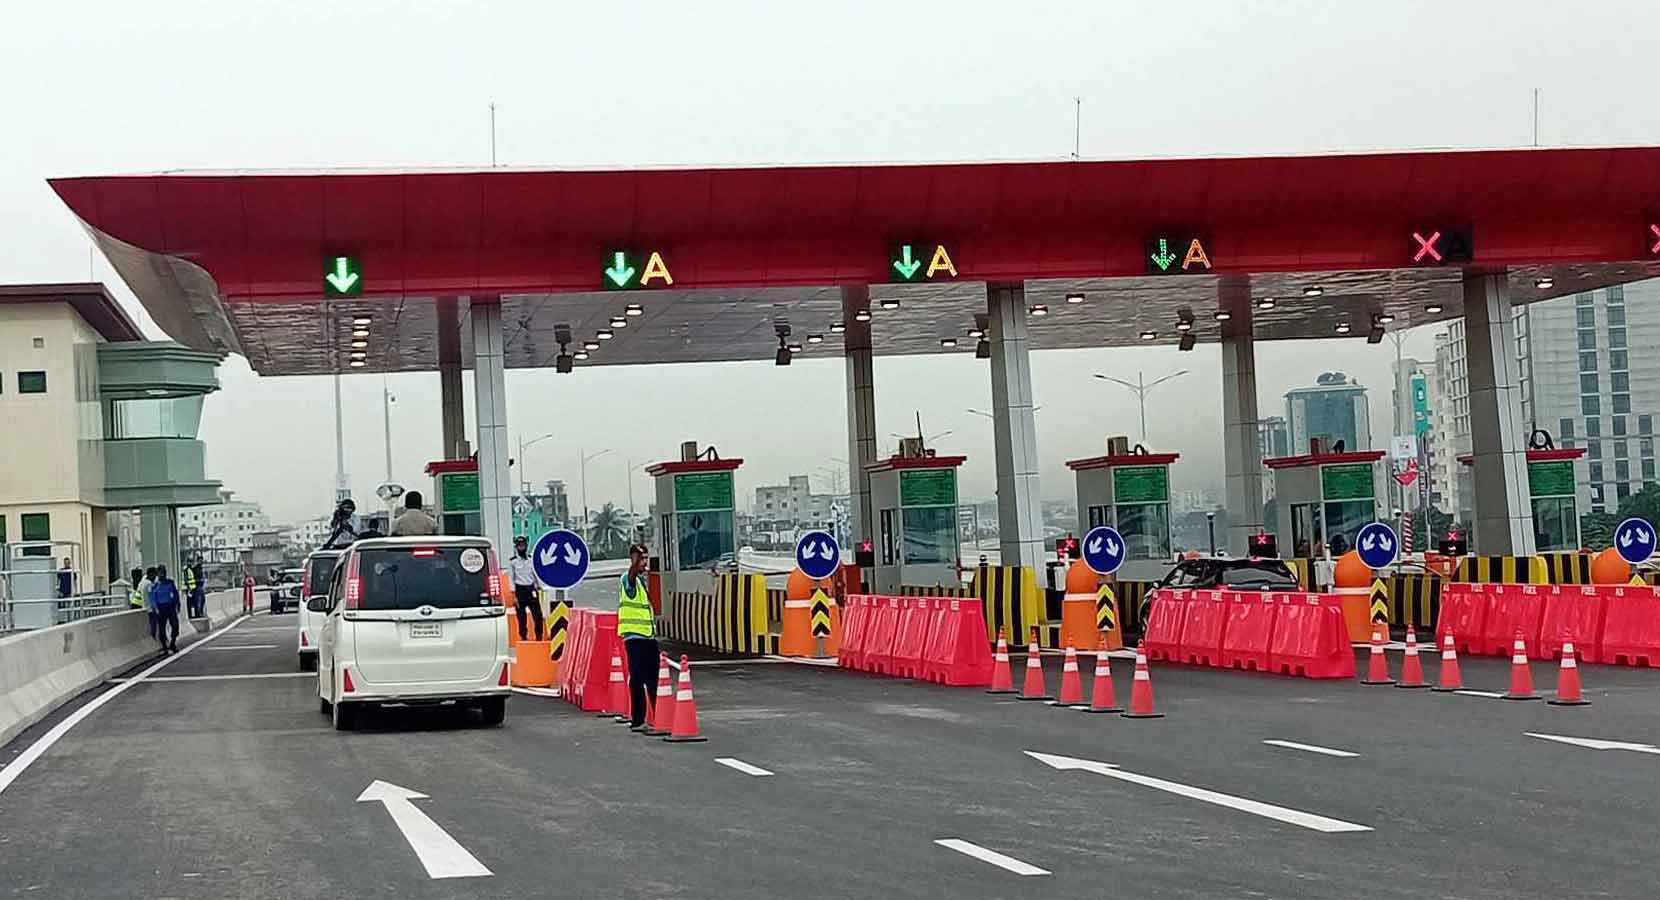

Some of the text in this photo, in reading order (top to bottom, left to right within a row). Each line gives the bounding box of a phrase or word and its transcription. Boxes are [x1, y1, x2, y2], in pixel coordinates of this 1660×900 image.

[640, 252, 674, 285] A
[926, 245, 958, 278] A
[1182, 238, 1212, 270] A
